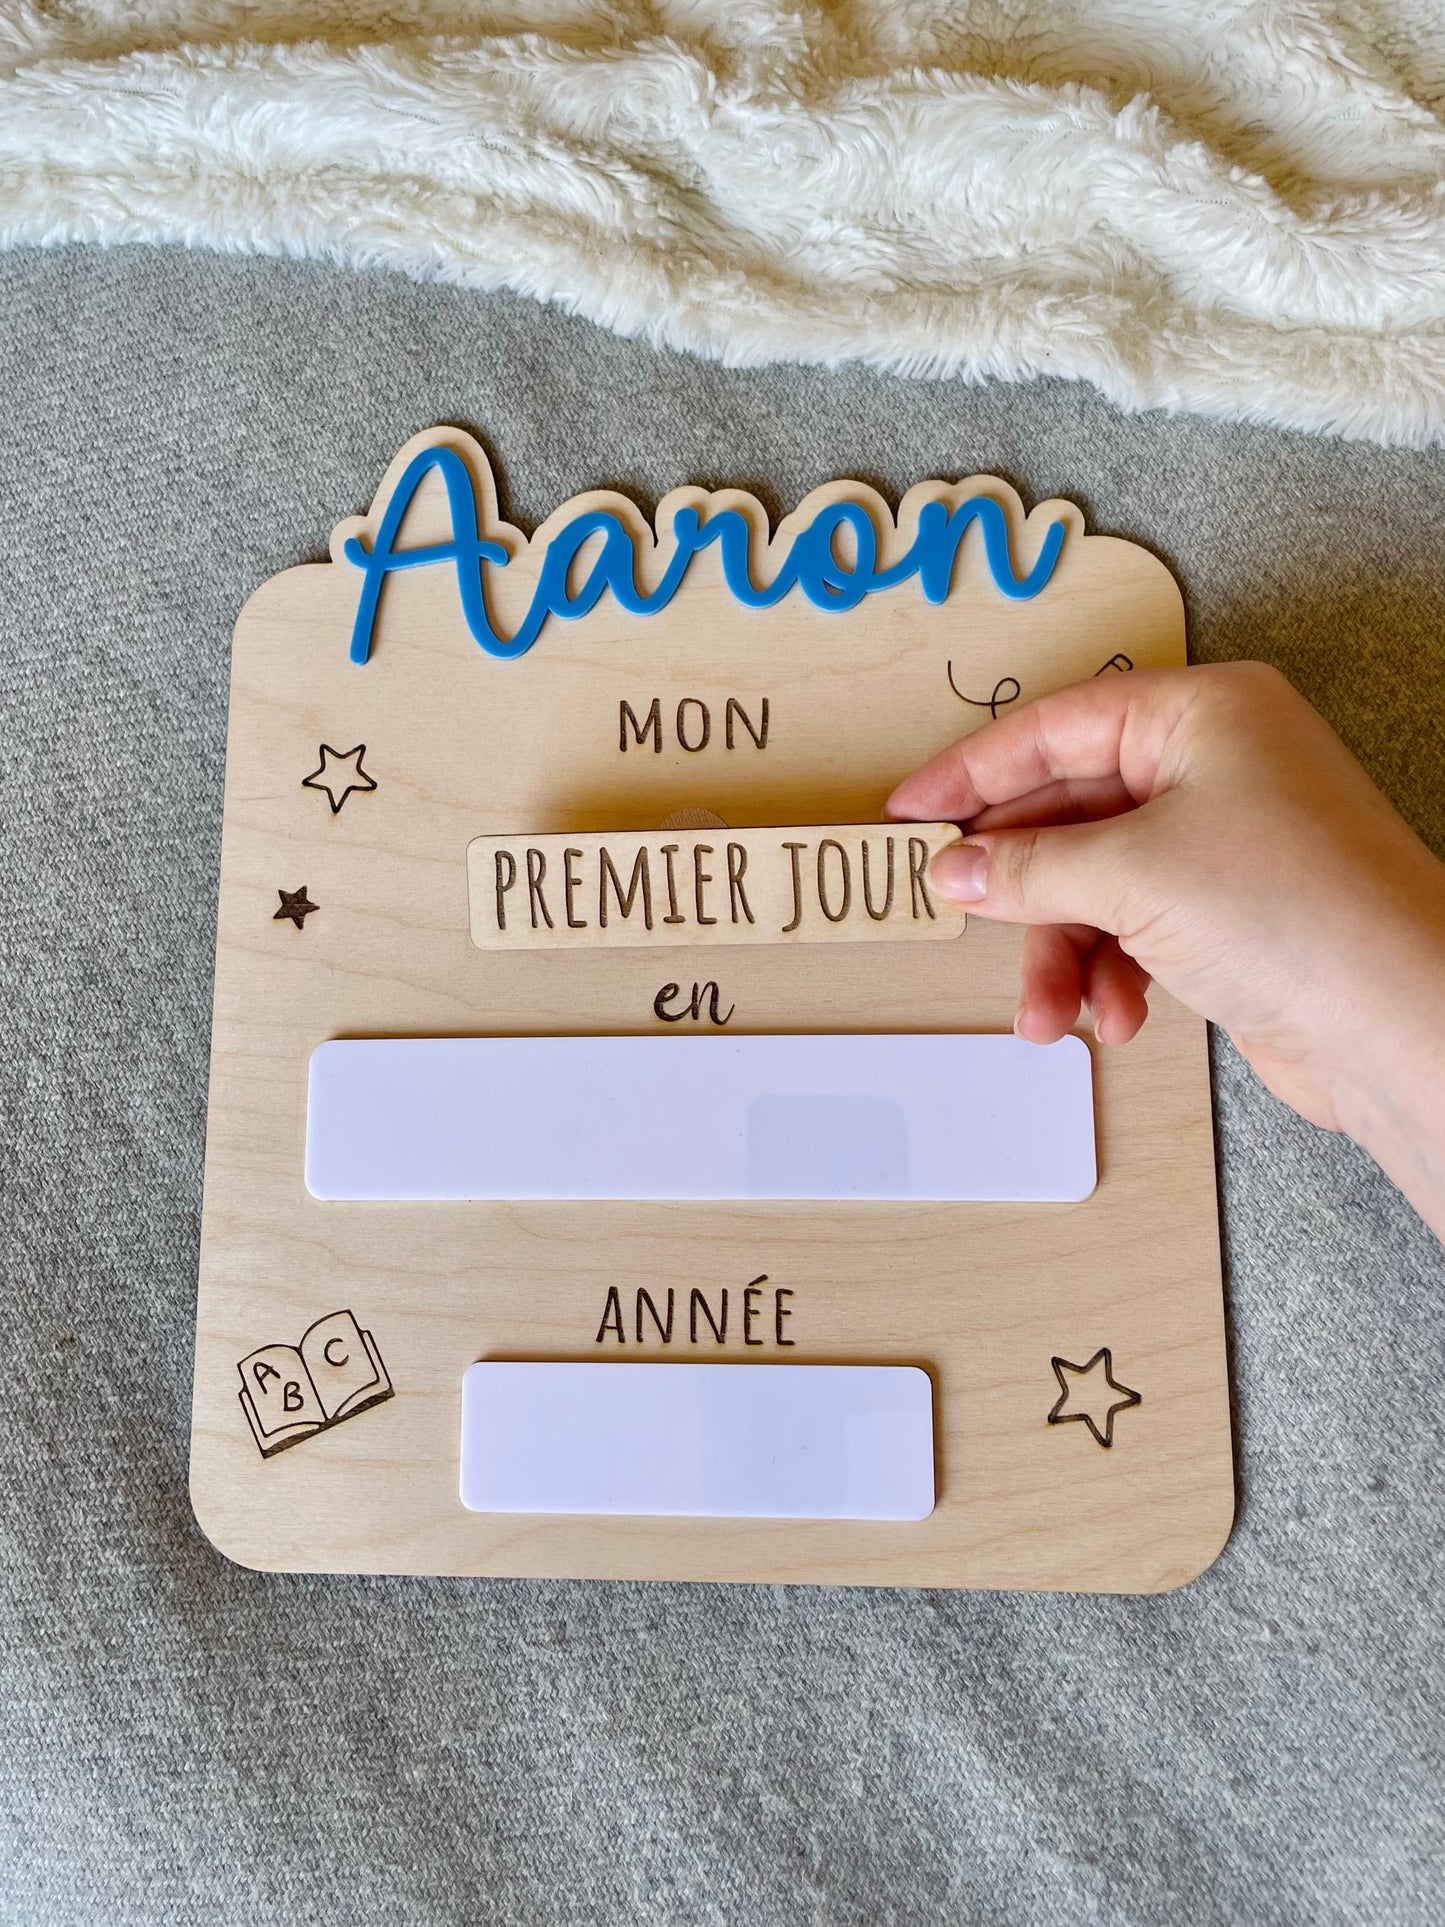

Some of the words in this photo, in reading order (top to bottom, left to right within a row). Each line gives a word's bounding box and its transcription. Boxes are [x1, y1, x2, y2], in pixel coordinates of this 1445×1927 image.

[344, 446, 1065, 664] Aaron
[619, 697, 770, 753] MON
[494, 842, 756, 932] PREMIER
[782, 836, 936, 932] JOUR
[653, 977, 735, 1026] en
[596, 1275, 797, 1347] ANNÉE
